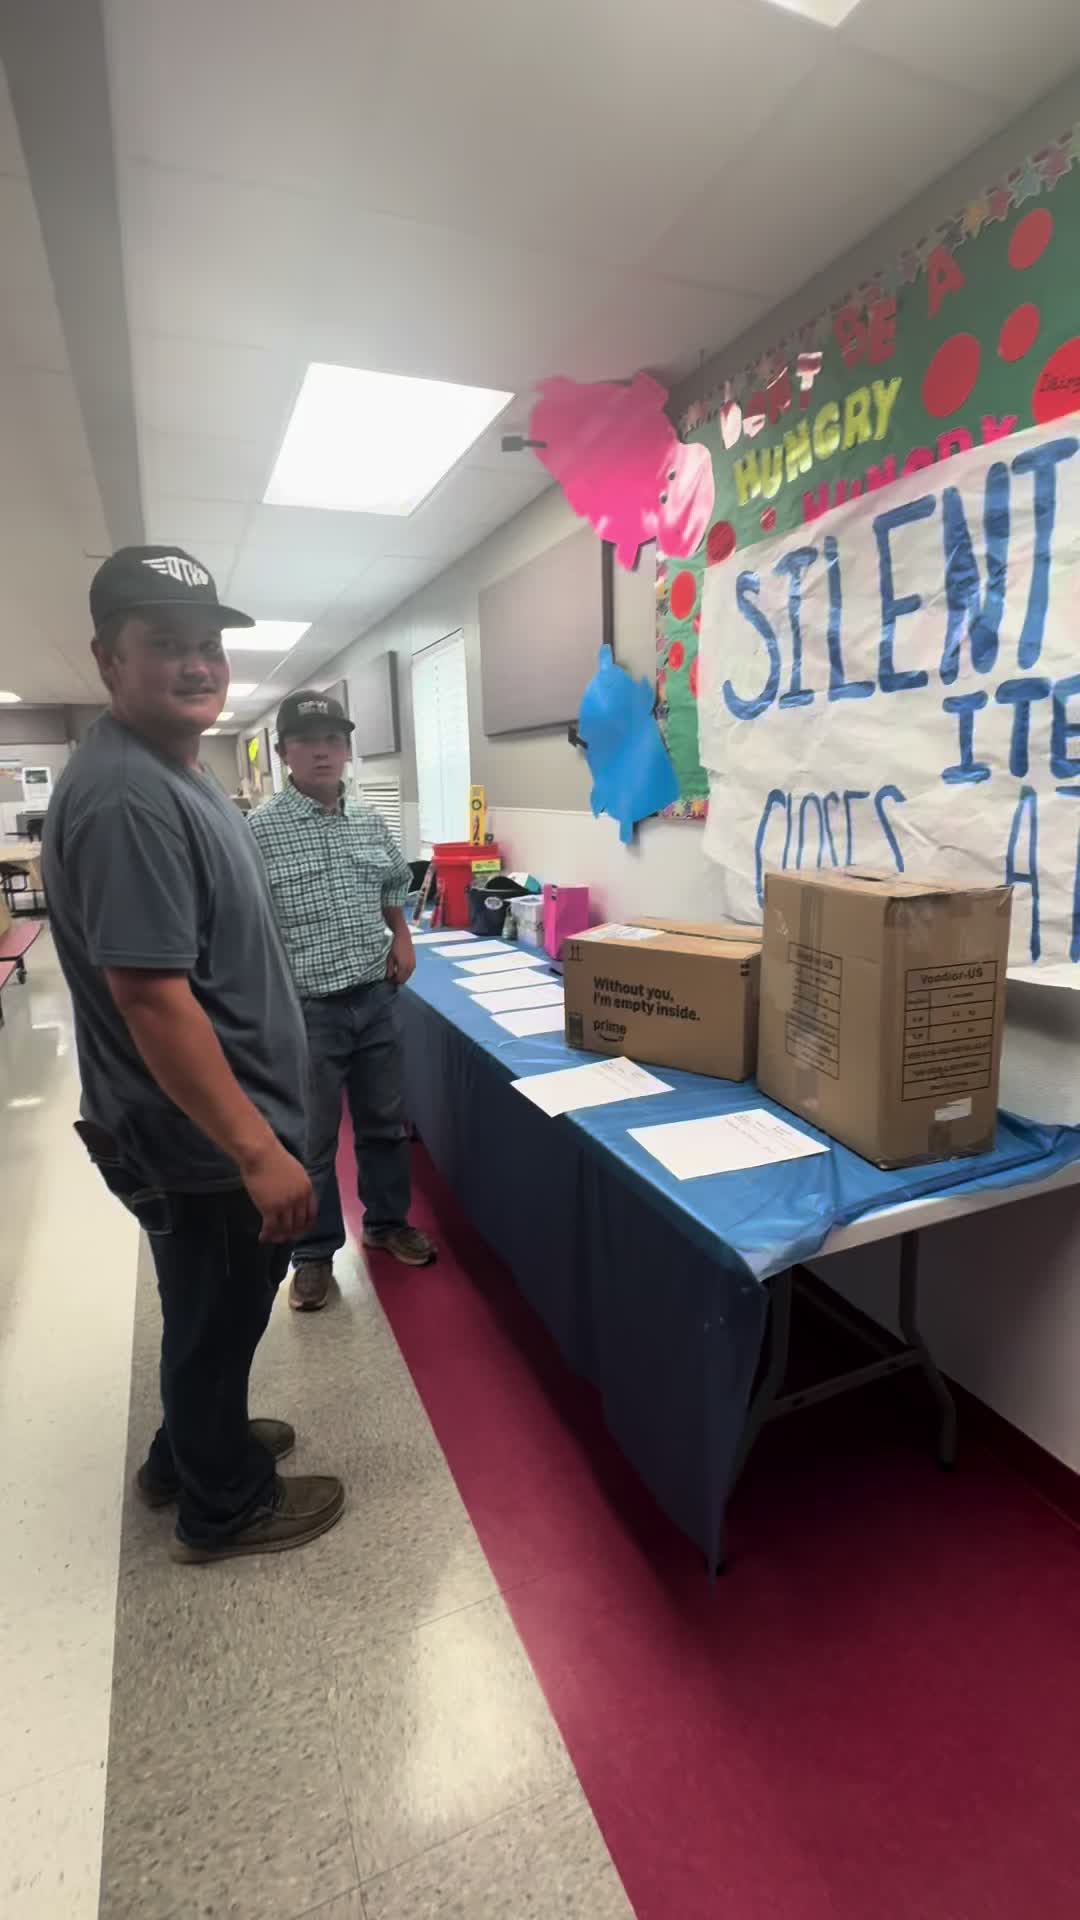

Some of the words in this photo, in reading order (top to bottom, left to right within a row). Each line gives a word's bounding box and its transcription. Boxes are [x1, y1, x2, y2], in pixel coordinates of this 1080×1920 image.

[733, 376, 902, 506] HUNGRY
[722, 436, 1080, 721] SILENT
[593, 976, 644, 997] Without
[593, 991, 612, 1007] I'm
[614, 998, 655, 1017] empty
[656, 1003, 701, 1021] inside.
[593, 1019, 627, 1035] prime
